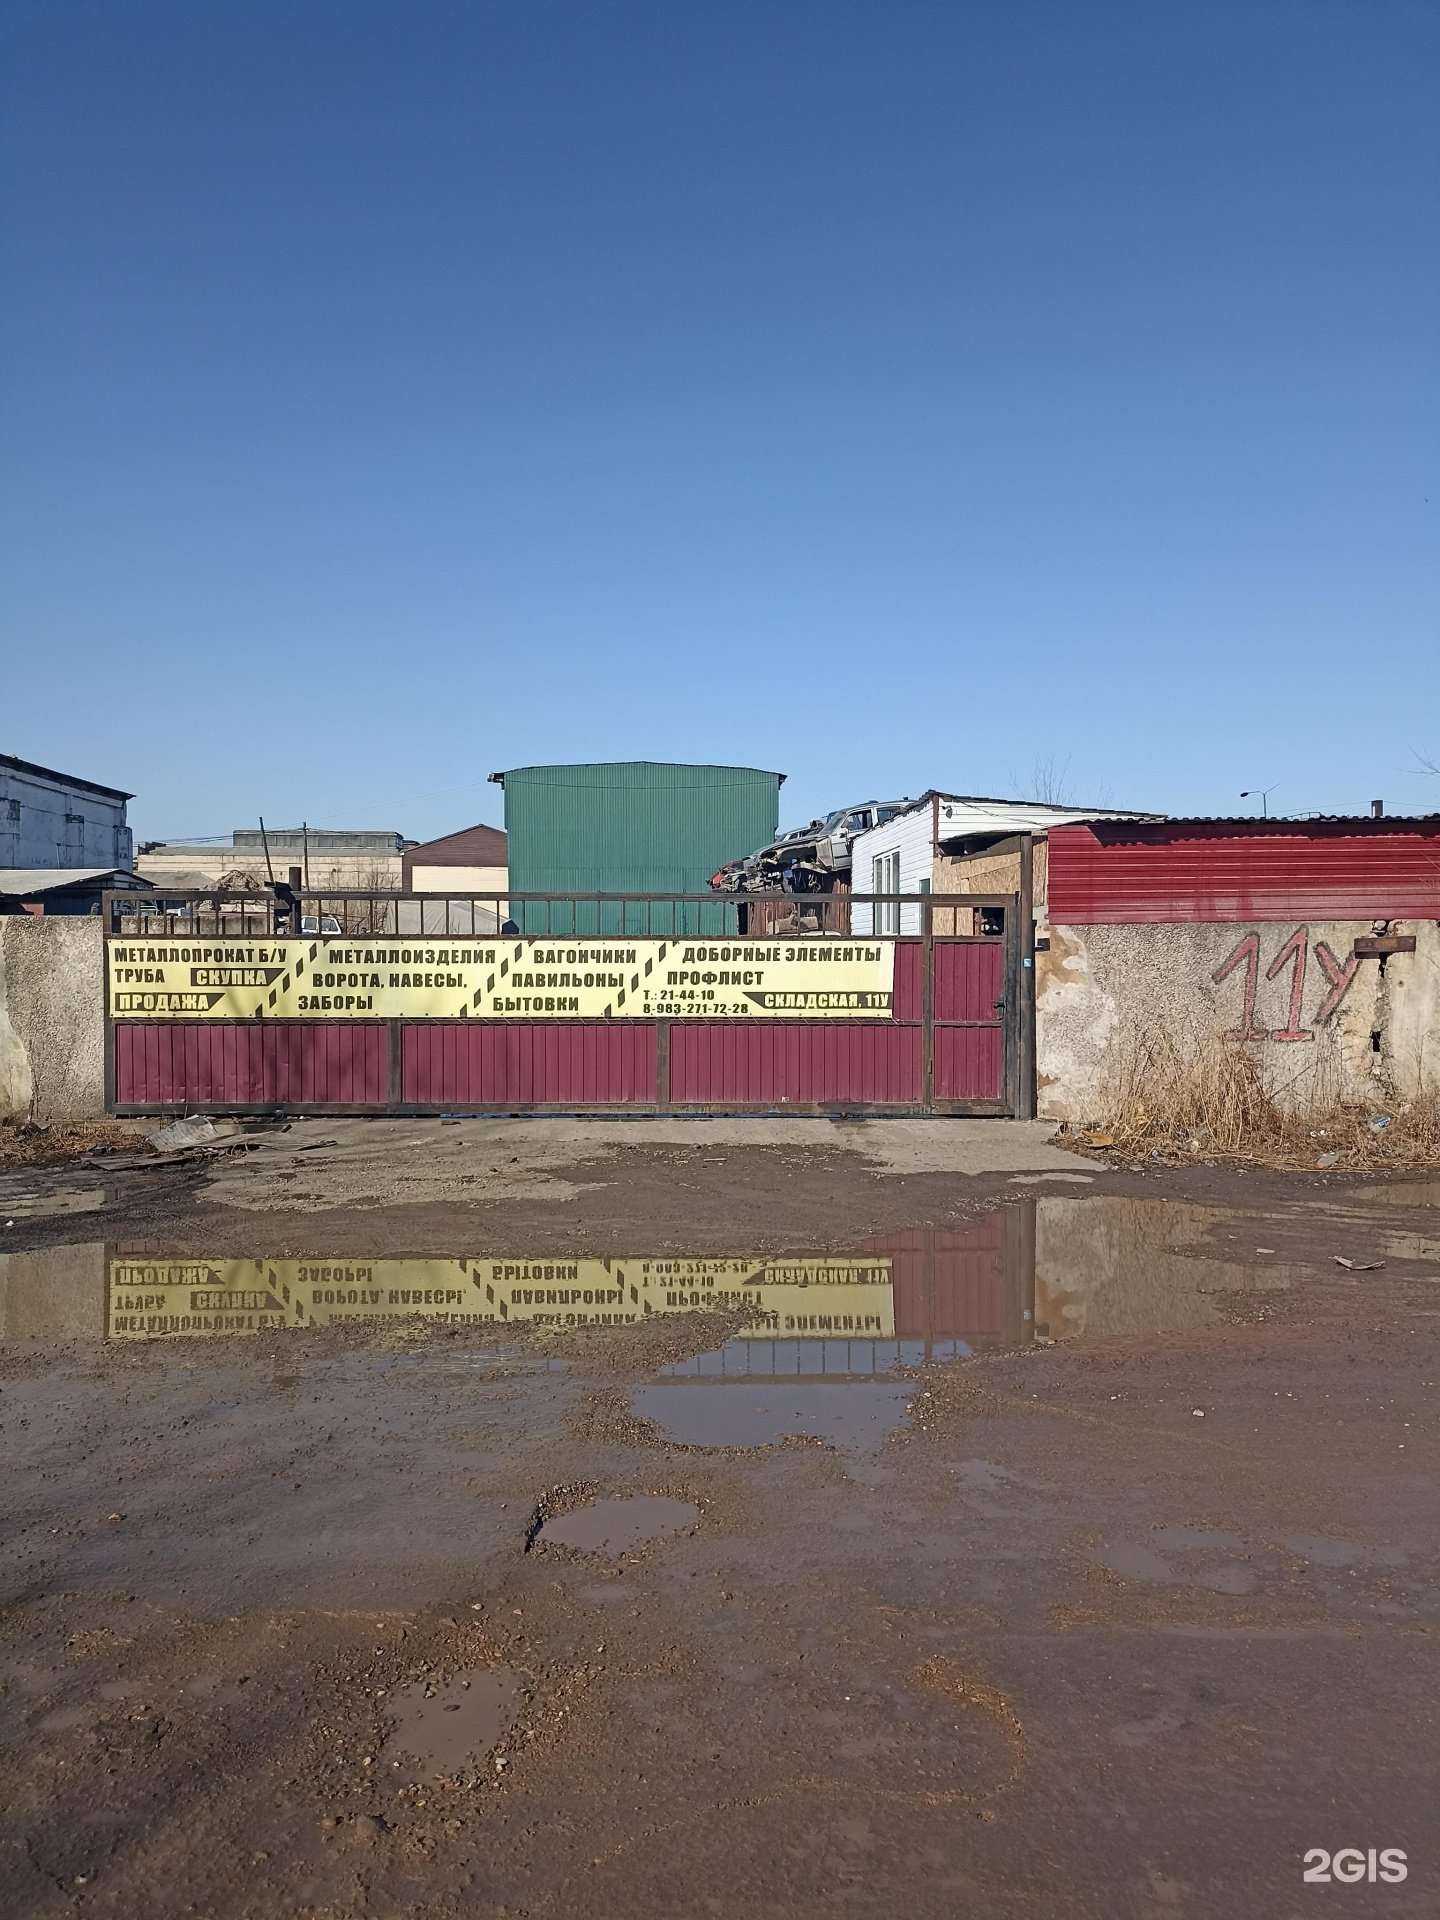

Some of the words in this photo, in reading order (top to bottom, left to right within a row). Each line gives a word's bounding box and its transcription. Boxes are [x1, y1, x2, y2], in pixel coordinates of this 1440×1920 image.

[114, 948, 255, 963] МЕТАЛЛОПРОКАТ
[258, 948, 287, 963] Б/У
[329, 949, 496, 966] МЕТАЛЛОИЗДЕЛИЯ
[534, 949, 636, 964] ВАГОНЧИКИ
[682, 947, 780, 963] ДОБОРНЫЕ
[785, 947, 881, 961] ЭЛЕМЕНТЫ
[115, 968, 165, 983] ТРУБА
[196, 970, 268, 985] СКУПКА
[312, 973, 385, 989] ВОРОТА,
[512, 973, 624, 988] ПАВИЛЬОНЫ
[667, 971, 764, 985] ПРОФЛИСТ
[298, 995, 372, 1010] ЗАБОРЫ
[660, 990, 715, 1000] 21-44-10
[865, 993, 889, 1007] 11У
[119, 995, 210, 1011] ПРОДАЖА
[493, 997, 579, 1012] БЫТОВКИ
[643, 1003, 748, 1014] 8-983-271-72-28
